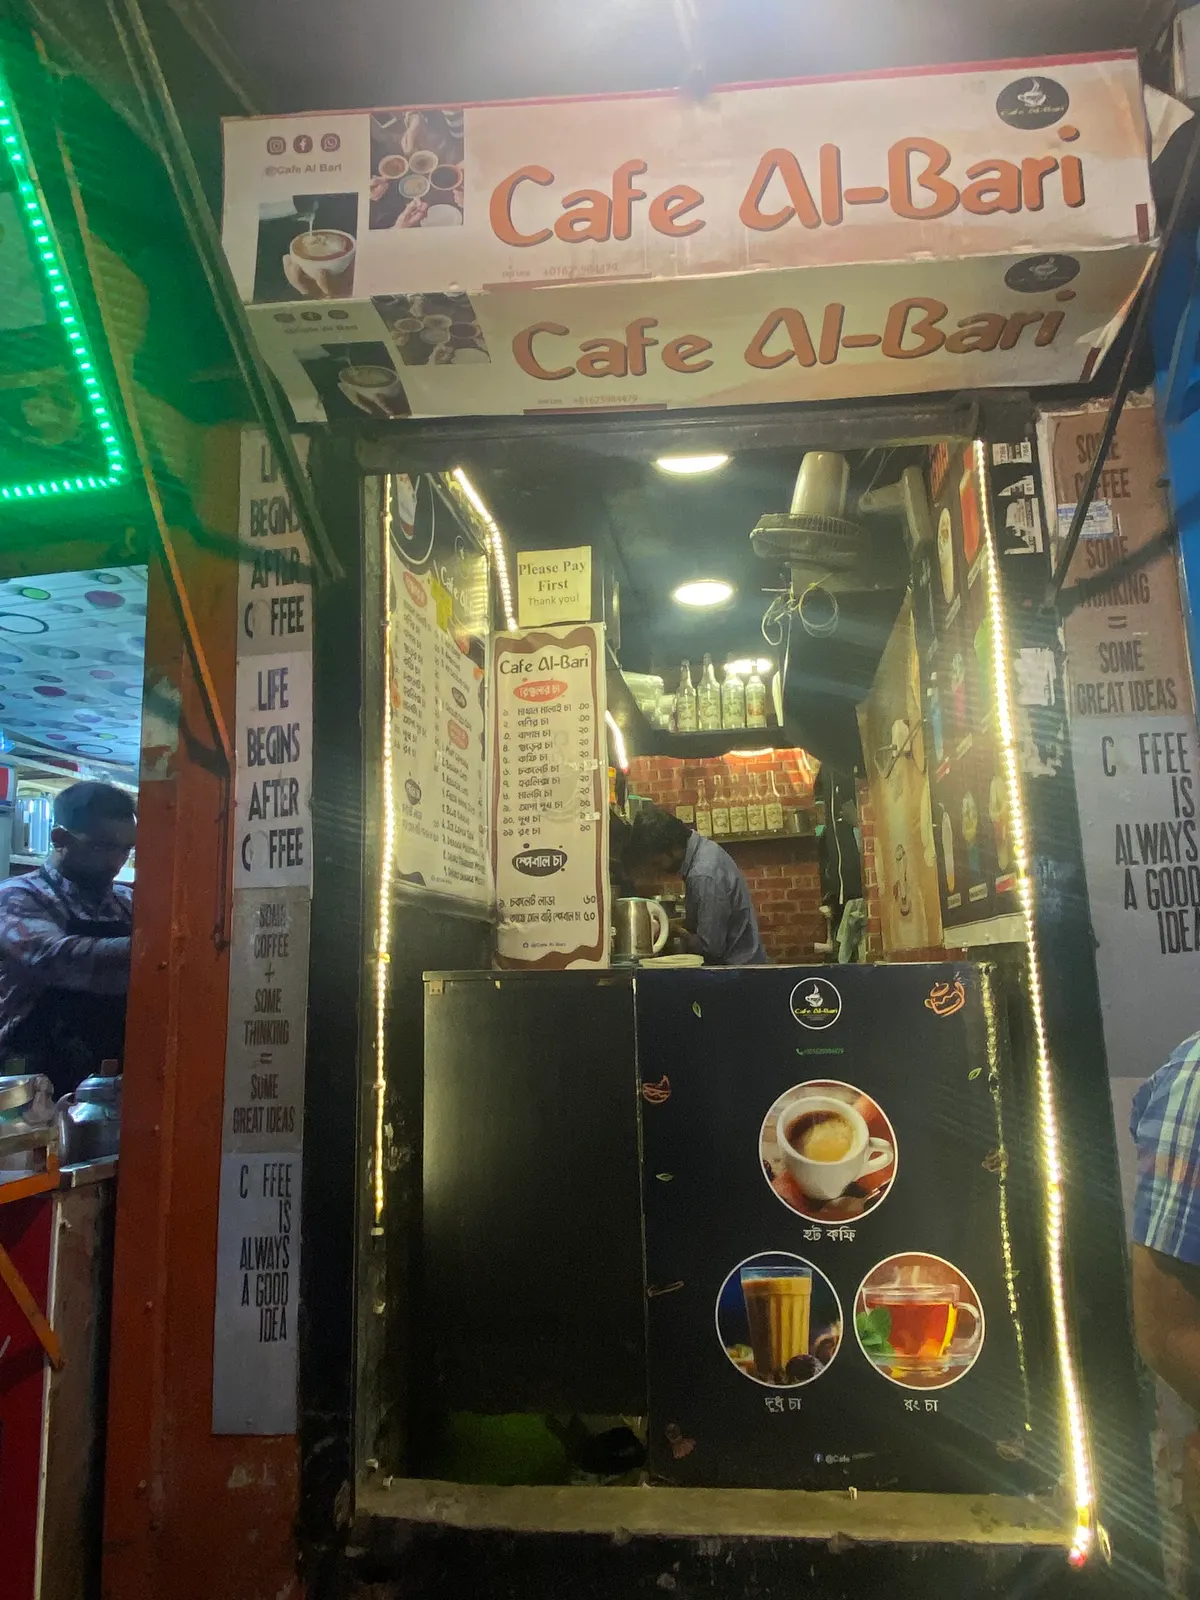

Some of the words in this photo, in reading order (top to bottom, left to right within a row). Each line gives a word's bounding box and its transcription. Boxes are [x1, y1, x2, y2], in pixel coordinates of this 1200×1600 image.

[304, 164, 316, 173] Al
[489, 158, 706, 247] Cafe
[739, 125, 1086, 231] Al-Bari
[511, 317, 714, 380] Cafe
[744, 289, 1077, 368] Al-Bari
[1076, 432, 1120, 464] SOE
[1074, 466, 1132, 501] CFEE
[1086, 535, 1129, 570] SOME
[518, 563, 559, 576] Please
[563, 560, 586, 573] Pay
[538, 578, 569, 592] First
[1075, 572, 1150, 608] NKING
[527, 595, 557, 606] Thank
[558, 593, 580, 605] you!
[500, 658, 534, 675] Cafe
[538, 653, 589, 671] Al-Bari
[1098, 639, 1145, 674] SOME
[257, 666, 289, 711] LIFE
[552, 684, 561, 694] চা
[1076, 681, 1126, 715] GREAT
[1128, 677, 1178, 712] IDEAS
[564, 704, 572, 712] চা
[540, 718, 549, 726] চা
[247, 722, 300, 767] BEGINS
[539, 753, 548, 761] চা
[544, 741, 553, 749] চা
[544, 789, 553, 797] চা
[551, 776, 561, 785] চা
[248, 777, 299, 821] AFTER
[554, 801, 563, 809] চা
[1172, 776, 1195, 818] IS
[532, 814, 541, 823] চা
[532, 827, 541, 835] চা
[1115, 819, 1199, 866] ALWAYS
[515, 855, 551, 869] স্পেশাল
[552, 854, 563, 867] চা
[583, 895, 596, 905] ৬০
[1124, 868, 1138, 910] A
[1145, 865, 1200, 910] GOOD
[253, 932, 289, 958] COFFEE
[254, 988, 282, 1013] SOME
[244, 1020, 289, 1045] THINKING
[250, 1073, 279, 1100] SOME
[233, 1107, 264, 1134] GREAT
[266, 1106, 296, 1133] IDEAS
[278, 1200, 292, 1234] IS
[803, 1224, 823, 1241] হট
[826, 1225, 857, 1242] কফি
[239, 1235, 290, 1271] ALWAYS
[241, 1273, 250, 1307] A
[255, 1272, 289, 1308] GOOD
[259, 1307, 288, 1343] IDEA
[764, 1395, 785, 1413] দুধ
[787, 1398, 802, 1411] চা
[903, 1398, 921, 1412] রং
[924, 1399, 939, 1412] চা
